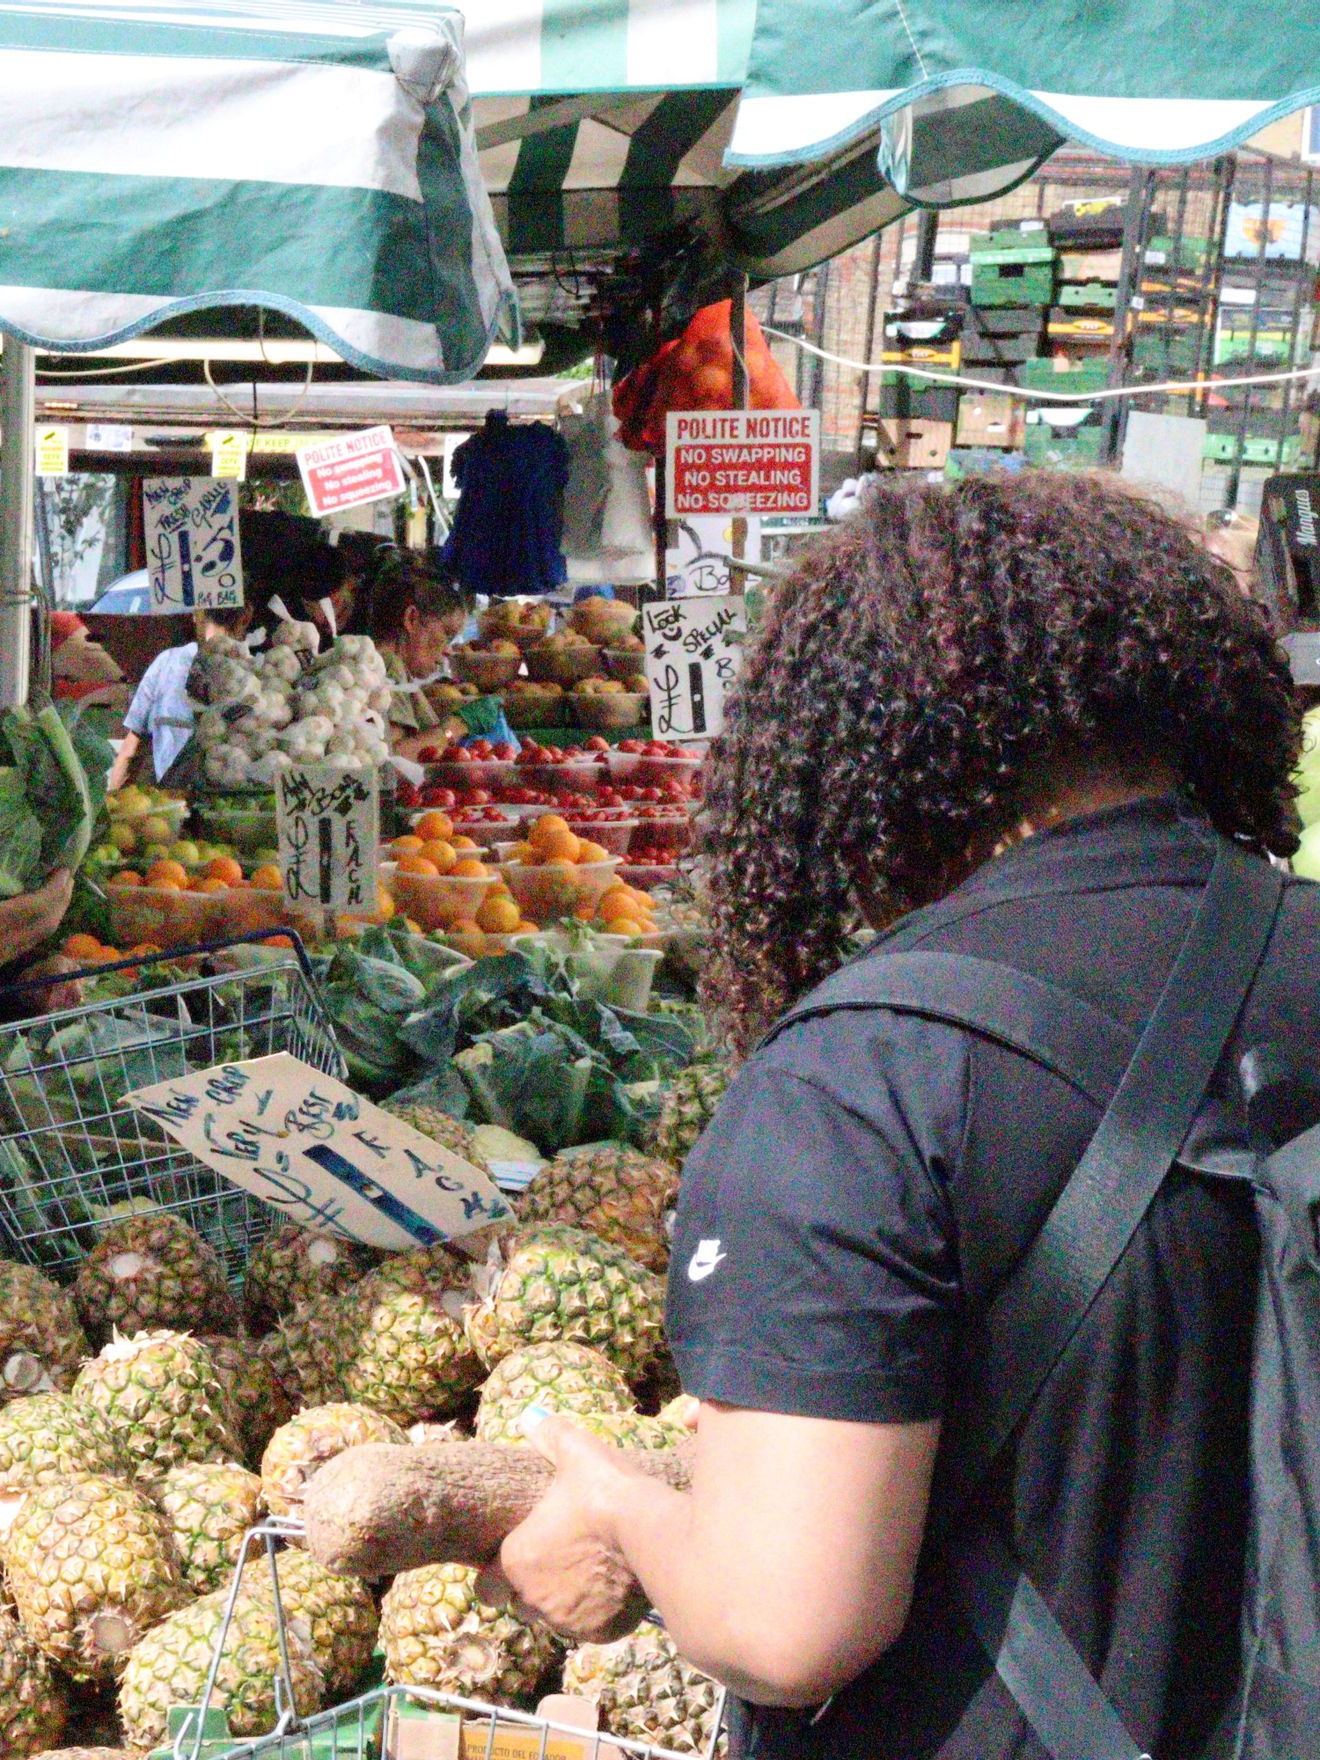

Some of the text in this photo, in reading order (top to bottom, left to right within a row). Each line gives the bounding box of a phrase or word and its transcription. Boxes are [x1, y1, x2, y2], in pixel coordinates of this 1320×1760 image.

[677, 416, 811, 439] POLITE NOTICE
[305, 444, 342, 465] POLITE
[346, 431, 387, 454] NOTICE
[680, 447, 806, 464] NO SWAPPING
[315, 466, 333, 478] No
[324, 467, 384, 491] No stealing
[684, 469, 802, 486] NO STEALING
[322, 480, 392, 506] No squeezing
[677, 493, 703, 509] NO
[204, 1065, 251, 1105] CROP
[284, 1089, 336, 1140] BEST
[467, 1744, 510, 1758] PRODCTO
